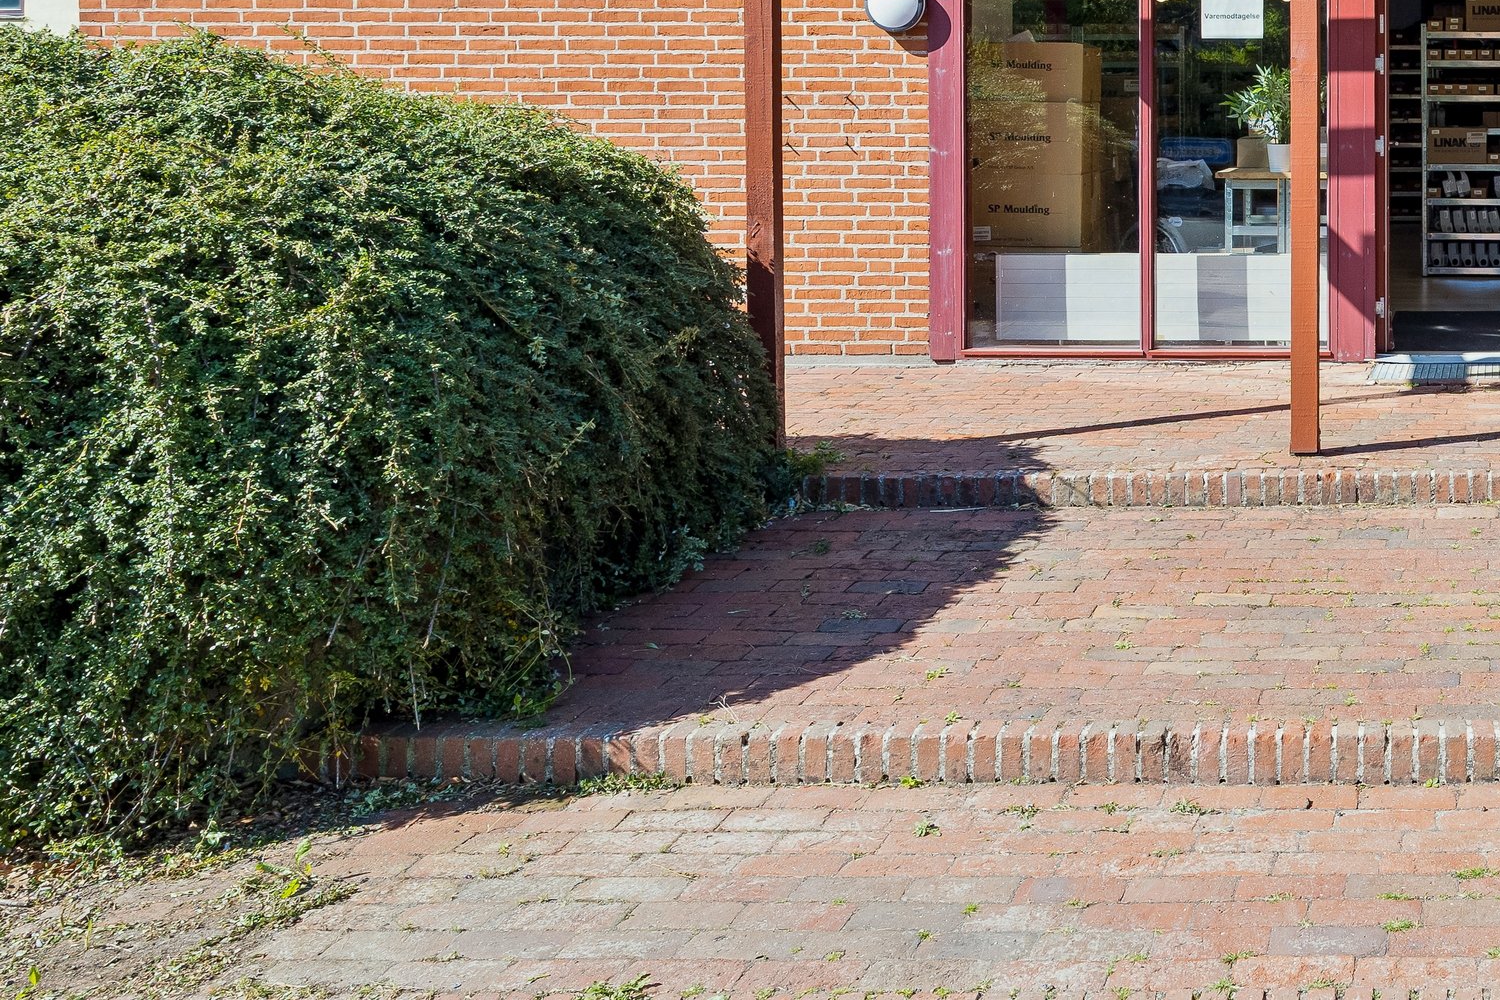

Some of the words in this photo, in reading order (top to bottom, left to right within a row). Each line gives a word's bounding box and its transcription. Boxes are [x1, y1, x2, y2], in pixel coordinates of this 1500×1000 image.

[1204, 13, 1261, 21] Varemodtagelse
[1006, 59, 1052, 71] Moulding
[1434, 138, 1467, 148] LINAK
[988, 204, 1001, 214] SP
[1003, 204, 1050, 216] Moulding
